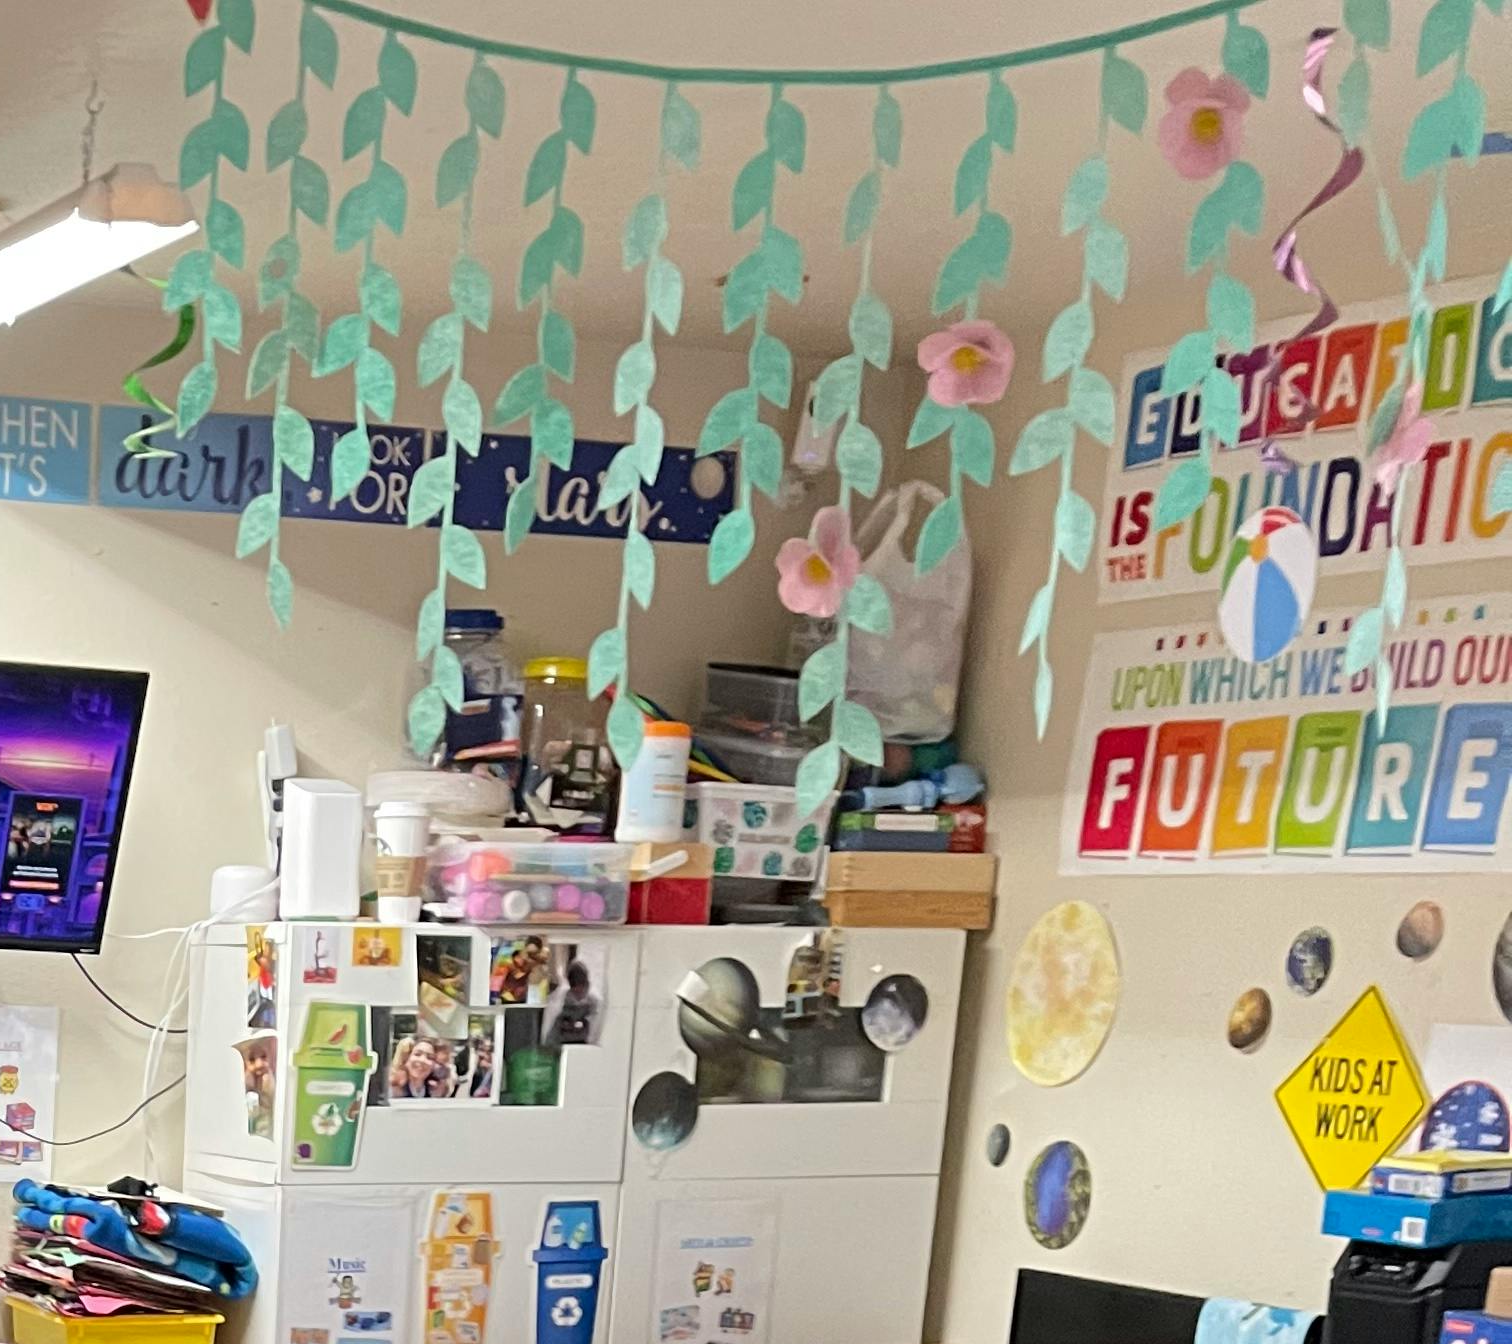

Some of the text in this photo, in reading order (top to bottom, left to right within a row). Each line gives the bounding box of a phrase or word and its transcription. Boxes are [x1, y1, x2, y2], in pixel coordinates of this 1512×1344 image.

[1109, 491, 1155, 548] IS
[1107, 555, 1148, 583] THE
[1110, 659, 1188, 712] UPON
[1190, 651, 1292, 706] WHICH
[1299, 645, 1351, 697] WE
[1097, 737, 1498, 831] FUTURE
[1308, 1056, 1399, 1096] KIDS AT
[1314, 1103, 1384, 1143] WORK
[327, 1257, 367, 1271] Music
